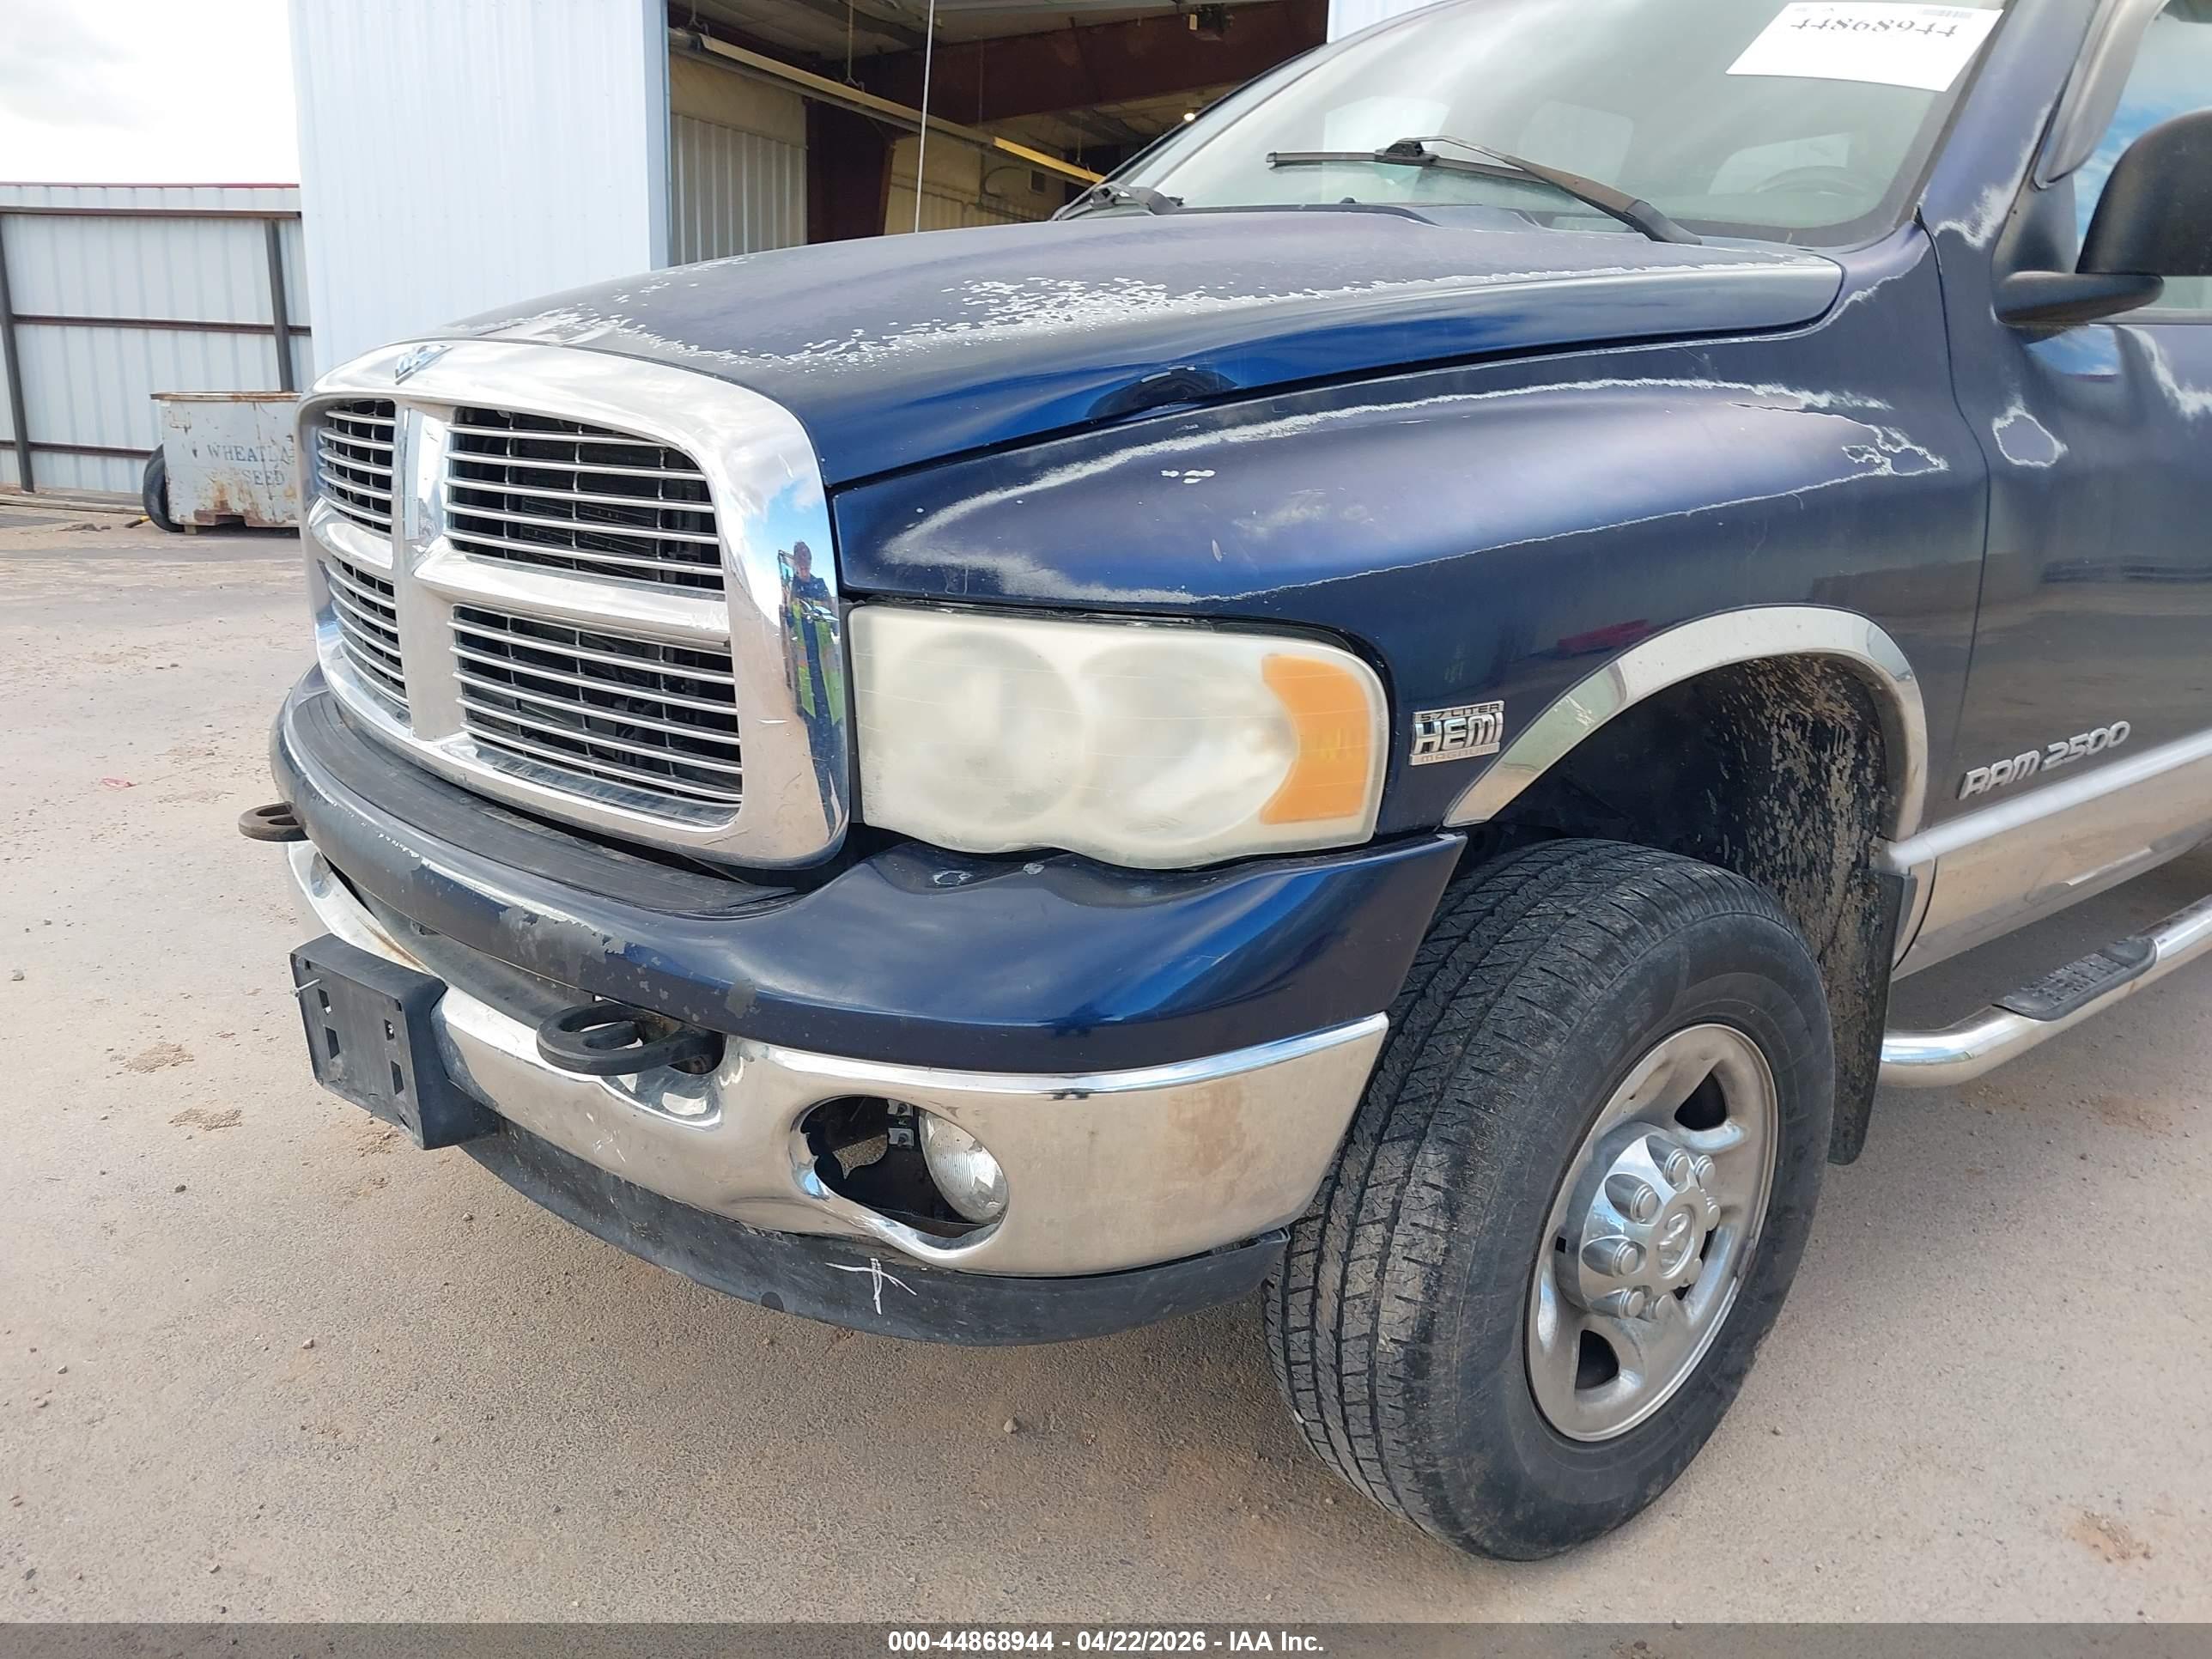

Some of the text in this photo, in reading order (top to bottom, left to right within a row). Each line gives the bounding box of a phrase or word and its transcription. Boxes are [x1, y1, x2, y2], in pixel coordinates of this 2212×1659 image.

[1790, 17, 1959, 37] 44868944
[241, 469, 286, 486] SEED
[1419, 703, 1500, 722] 5.7 LITER
[1413, 712, 1504, 755] HEMI
[1957, 720, 2131, 800] RAM 2500
